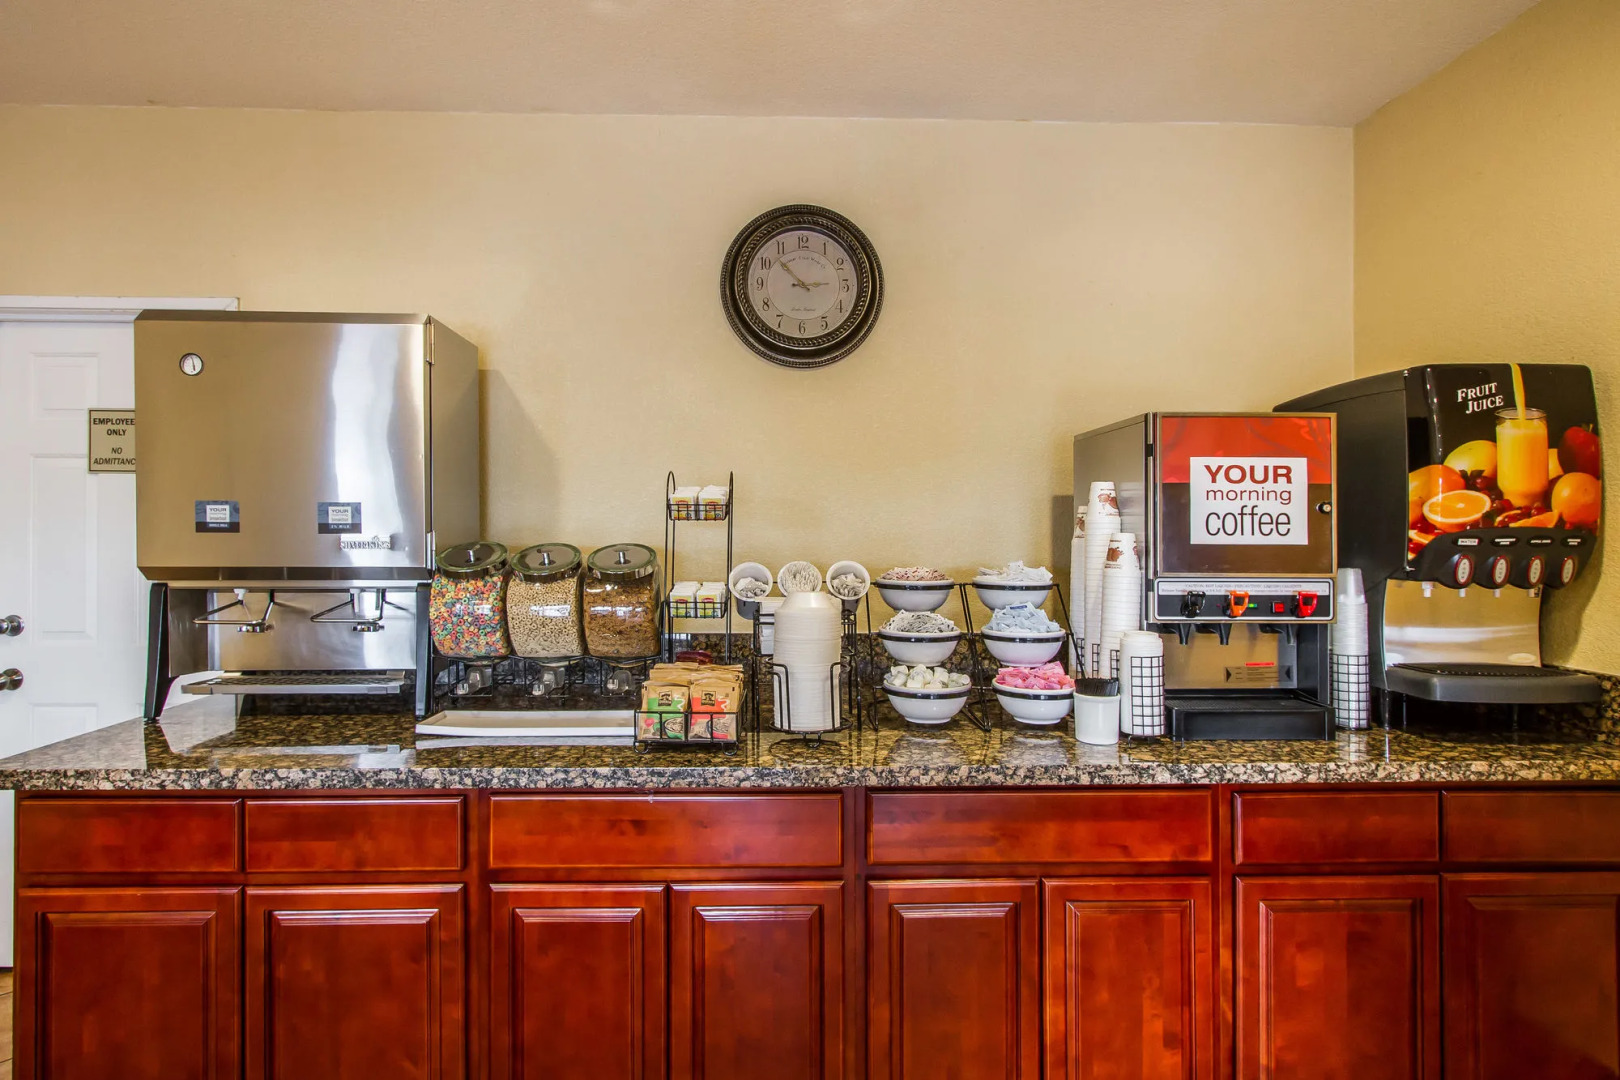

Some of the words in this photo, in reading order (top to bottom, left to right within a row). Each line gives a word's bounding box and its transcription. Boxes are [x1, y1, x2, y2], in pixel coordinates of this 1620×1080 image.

[776, 241, 784, 254] 11
[798, 235, 809, 249] 12
[823, 242, 827, 255] 1
[760, 257, 771, 270] 10
[836, 258, 844, 271] 2
[756, 277, 764, 291] 9
[842, 279, 850, 293] 3
[762, 297, 770, 311] 8
[835, 299, 843, 313] 4
[776, 314, 784, 329] 7
[798, 320, 806, 334] 6
[821, 316, 828, 330] 5
[1457, 382, 1497, 402] FRUIT
[1465, 395, 1504, 414] JUICE
[93, 418, 136, 426] EMPLOYEE
[111, 447, 123, 455] NO
[93, 457, 136, 466] ADMITTANC
[1204, 464, 1292, 484] YOUR
[1206, 487, 1292, 505] morning
[1205, 505, 1291, 536] coffee
